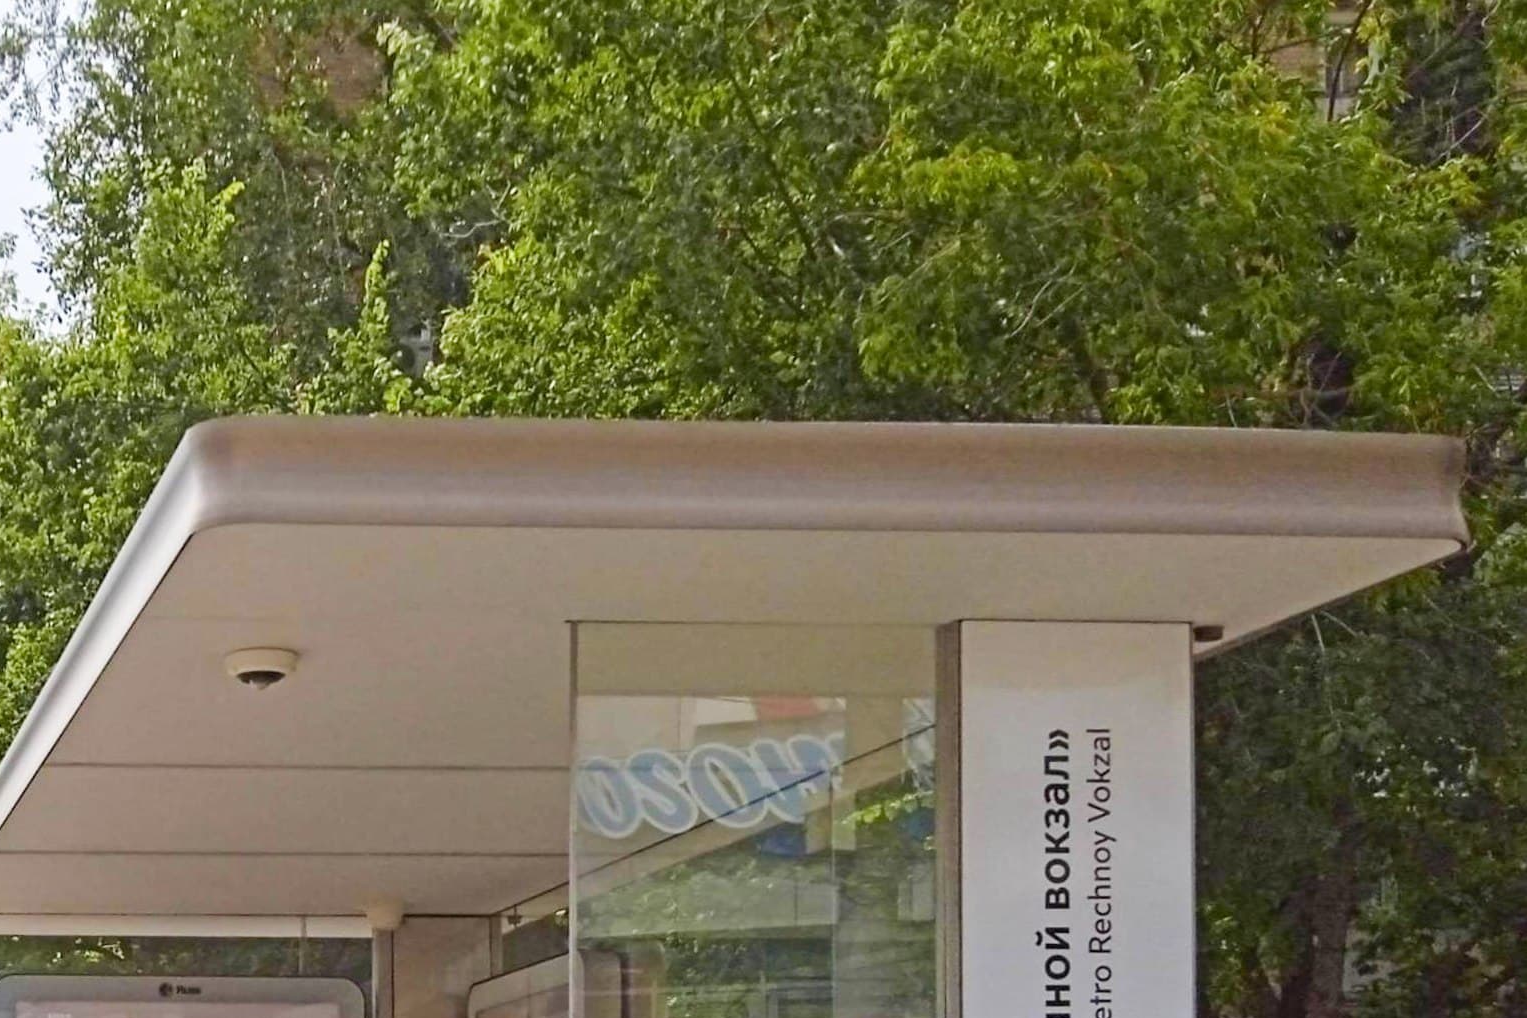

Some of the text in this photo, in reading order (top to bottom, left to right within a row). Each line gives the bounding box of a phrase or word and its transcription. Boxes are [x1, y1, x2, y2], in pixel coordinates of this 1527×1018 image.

[1044, 729, 1071, 910] вокзал»
[1086, 728, 1111, 825] Vokzal
[1087, 830, 1116, 954] Rechnoy
